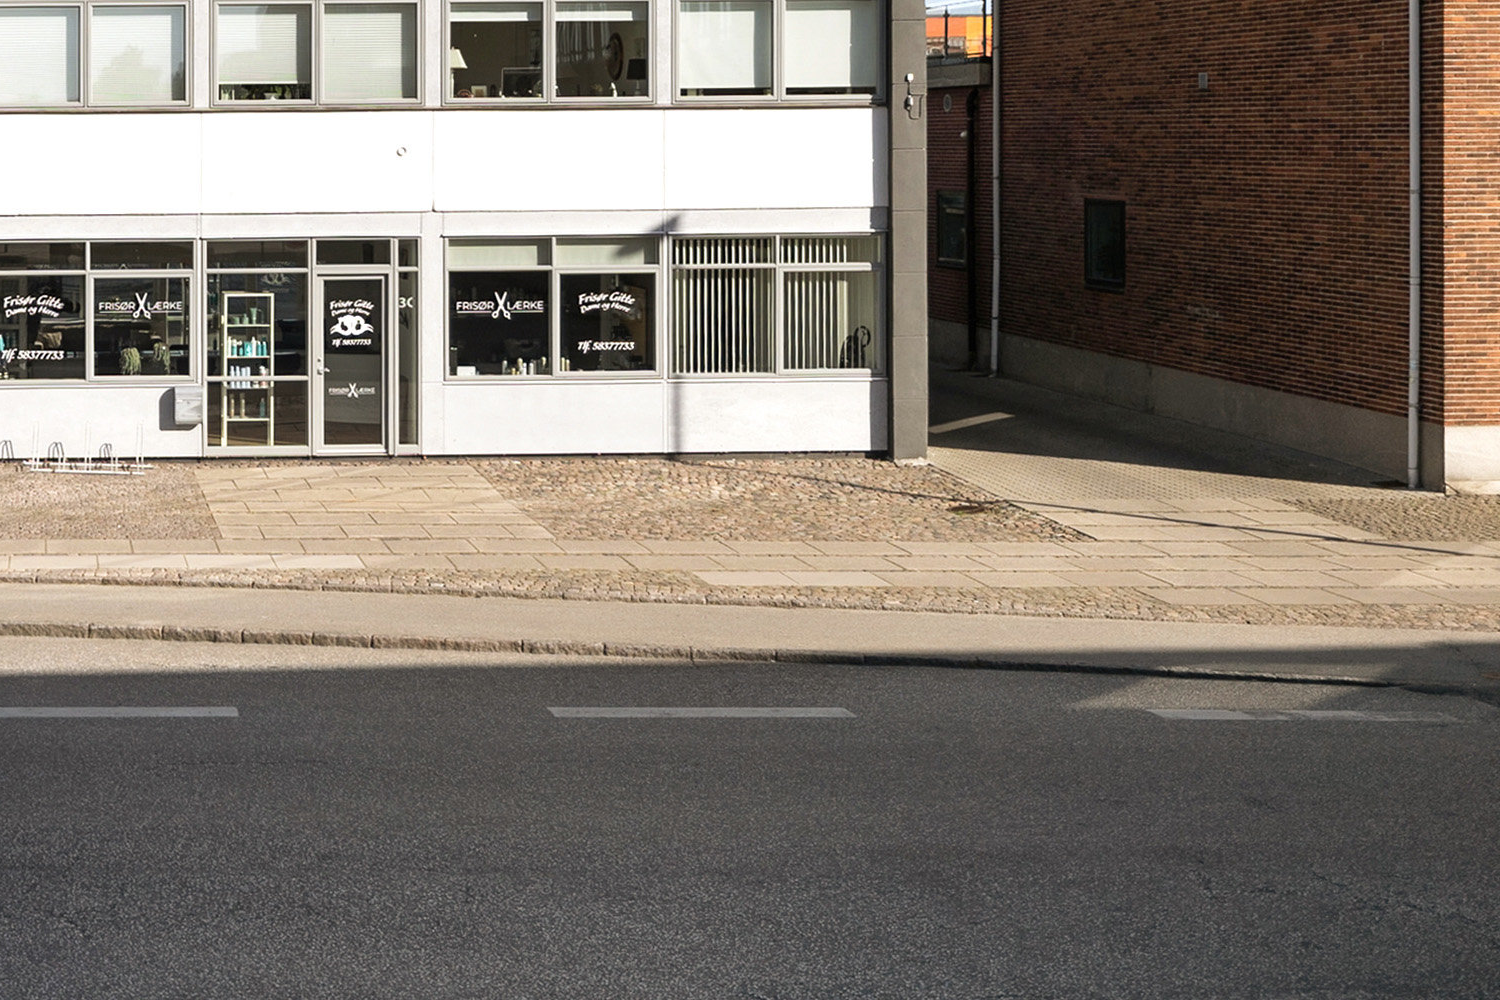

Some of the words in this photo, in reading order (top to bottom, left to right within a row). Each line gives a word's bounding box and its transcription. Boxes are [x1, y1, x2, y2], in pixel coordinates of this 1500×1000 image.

[3, 295, 37, 308] Frisør
[37, 294, 65, 309] Gitte
[578, 292, 609, 305] Frisør
[609, 291, 636, 305] Gitte
[98, 301, 136, 310] FRISØR
[147, 301, 183, 310] LÆRKE
[456, 301, 495, 310] FRISØR
[507, 301, 544, 310] LÆRKE
[17, 349, 65, 360] 58377733
